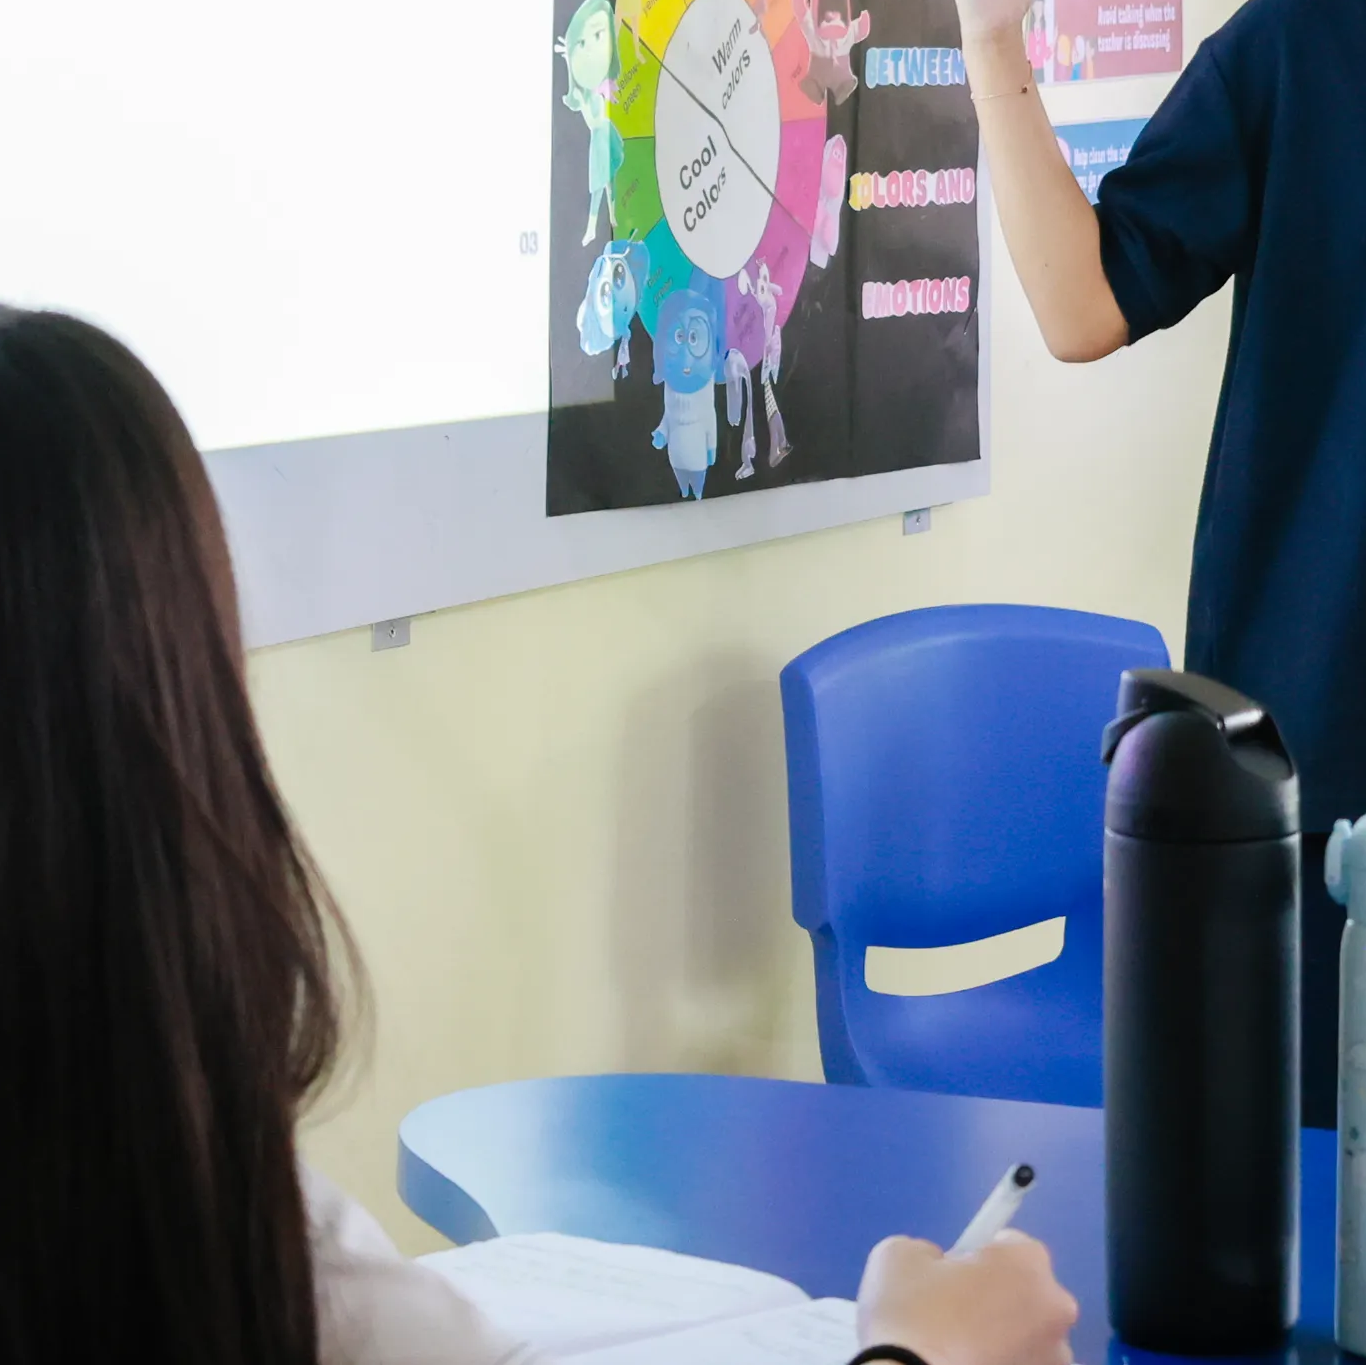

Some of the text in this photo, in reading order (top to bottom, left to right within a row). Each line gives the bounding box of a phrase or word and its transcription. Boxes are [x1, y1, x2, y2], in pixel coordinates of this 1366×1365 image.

[712, 18, 741, 75] Warm
[722, 49, 750, 109] colors
[679, 135, 717, 190] Cool
[935, 167, 975, 205] AND
[683, 166, 727, 232] Colors
[519, 230, 539, 256] 03
[862, 275, 970, 319] EMOTIONS
